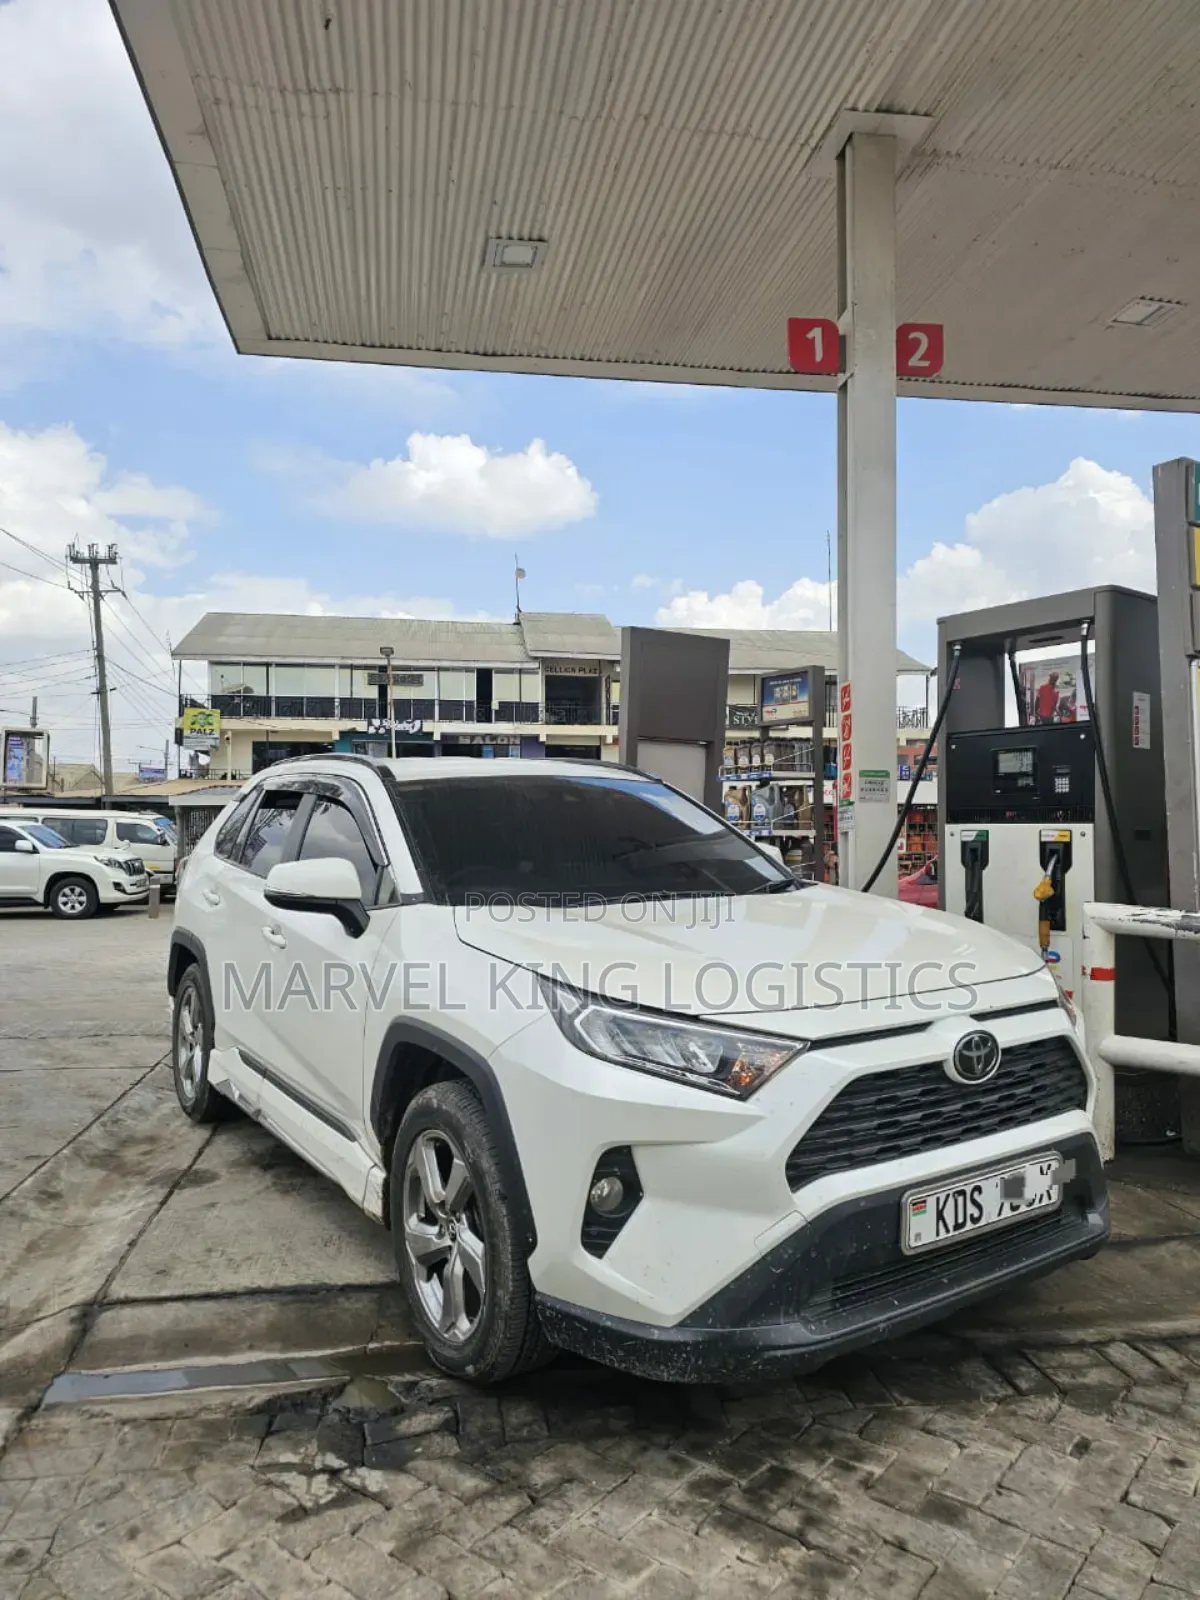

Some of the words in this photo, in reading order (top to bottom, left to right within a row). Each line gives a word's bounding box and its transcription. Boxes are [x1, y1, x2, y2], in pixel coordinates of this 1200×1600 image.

[805, 327, 823, 363] 1
[908, 331, 931, 367] 2
[459, 735, 520, 745] SALON
[935, 1184, 984, 1237] KDS
